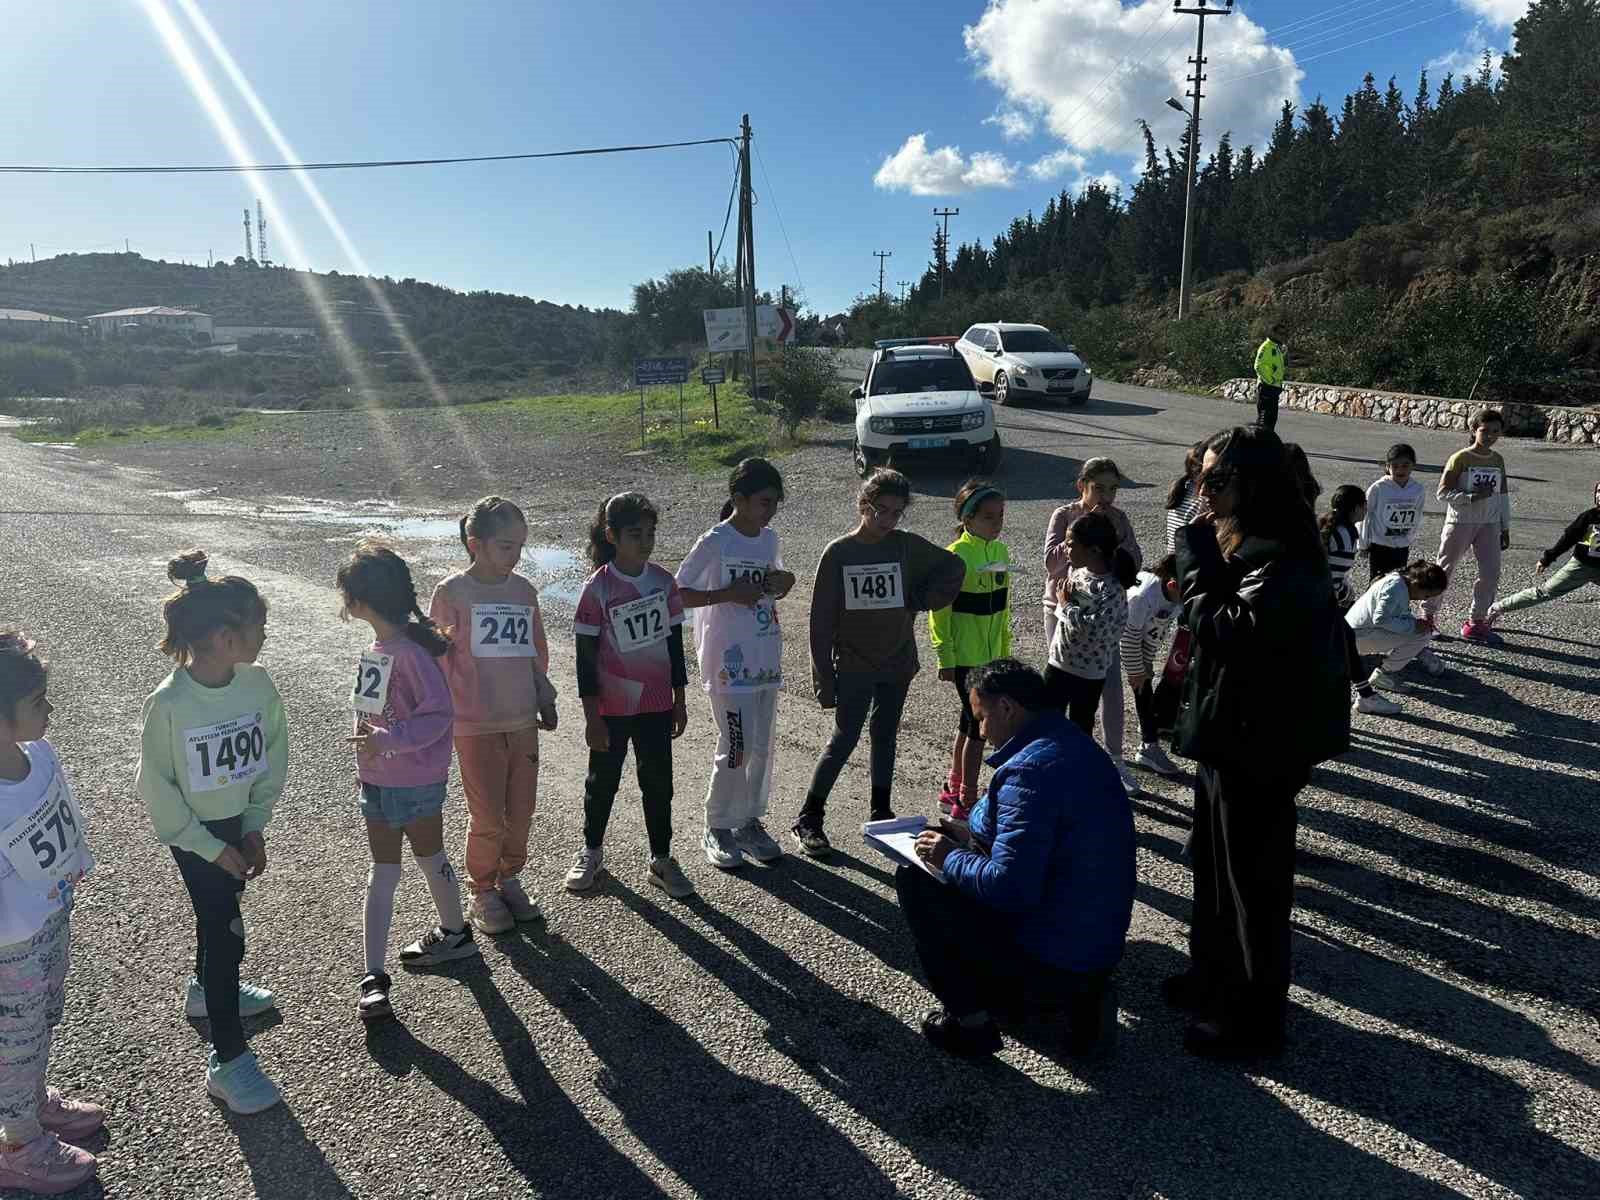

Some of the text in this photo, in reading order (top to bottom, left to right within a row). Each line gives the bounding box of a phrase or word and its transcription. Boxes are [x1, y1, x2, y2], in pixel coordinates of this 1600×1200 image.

[1390, 510, 1415, 524] 477
[850, 574, 896, 599] 1481
[480, 616, 528, 645] 242
[623, 608, 663, 640] 172
[196, 726, 264, 777] 1490
[28, 799, 77, 870] 579
